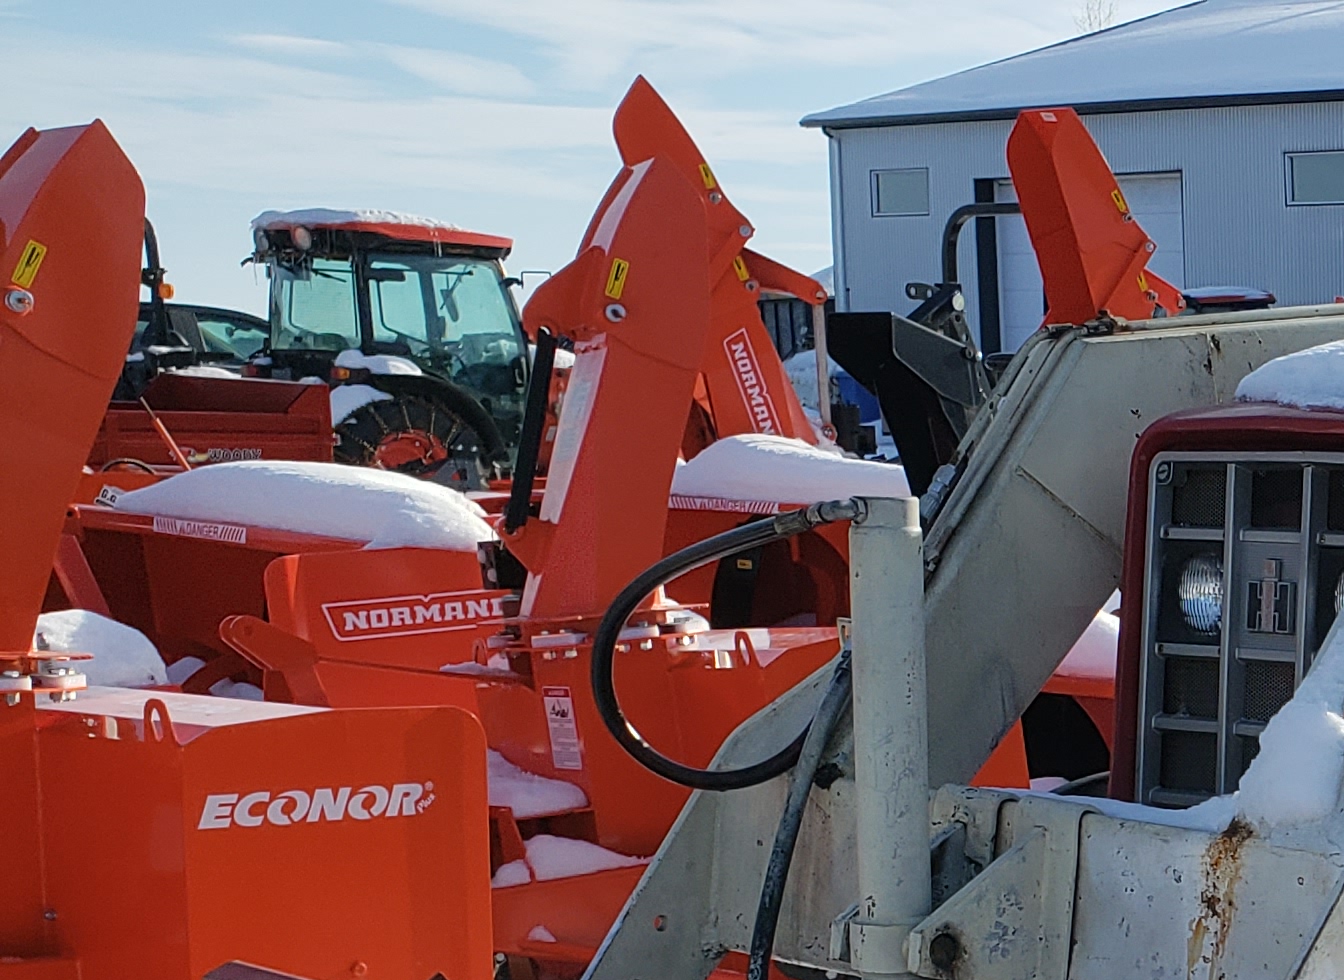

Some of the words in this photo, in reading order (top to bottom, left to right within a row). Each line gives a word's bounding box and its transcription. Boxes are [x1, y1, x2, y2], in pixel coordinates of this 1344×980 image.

[731, 342, 775, 435] NORMAN
[187, 522, 219, 539] DANGER
[197, 782, 424, 830] ECONOR
